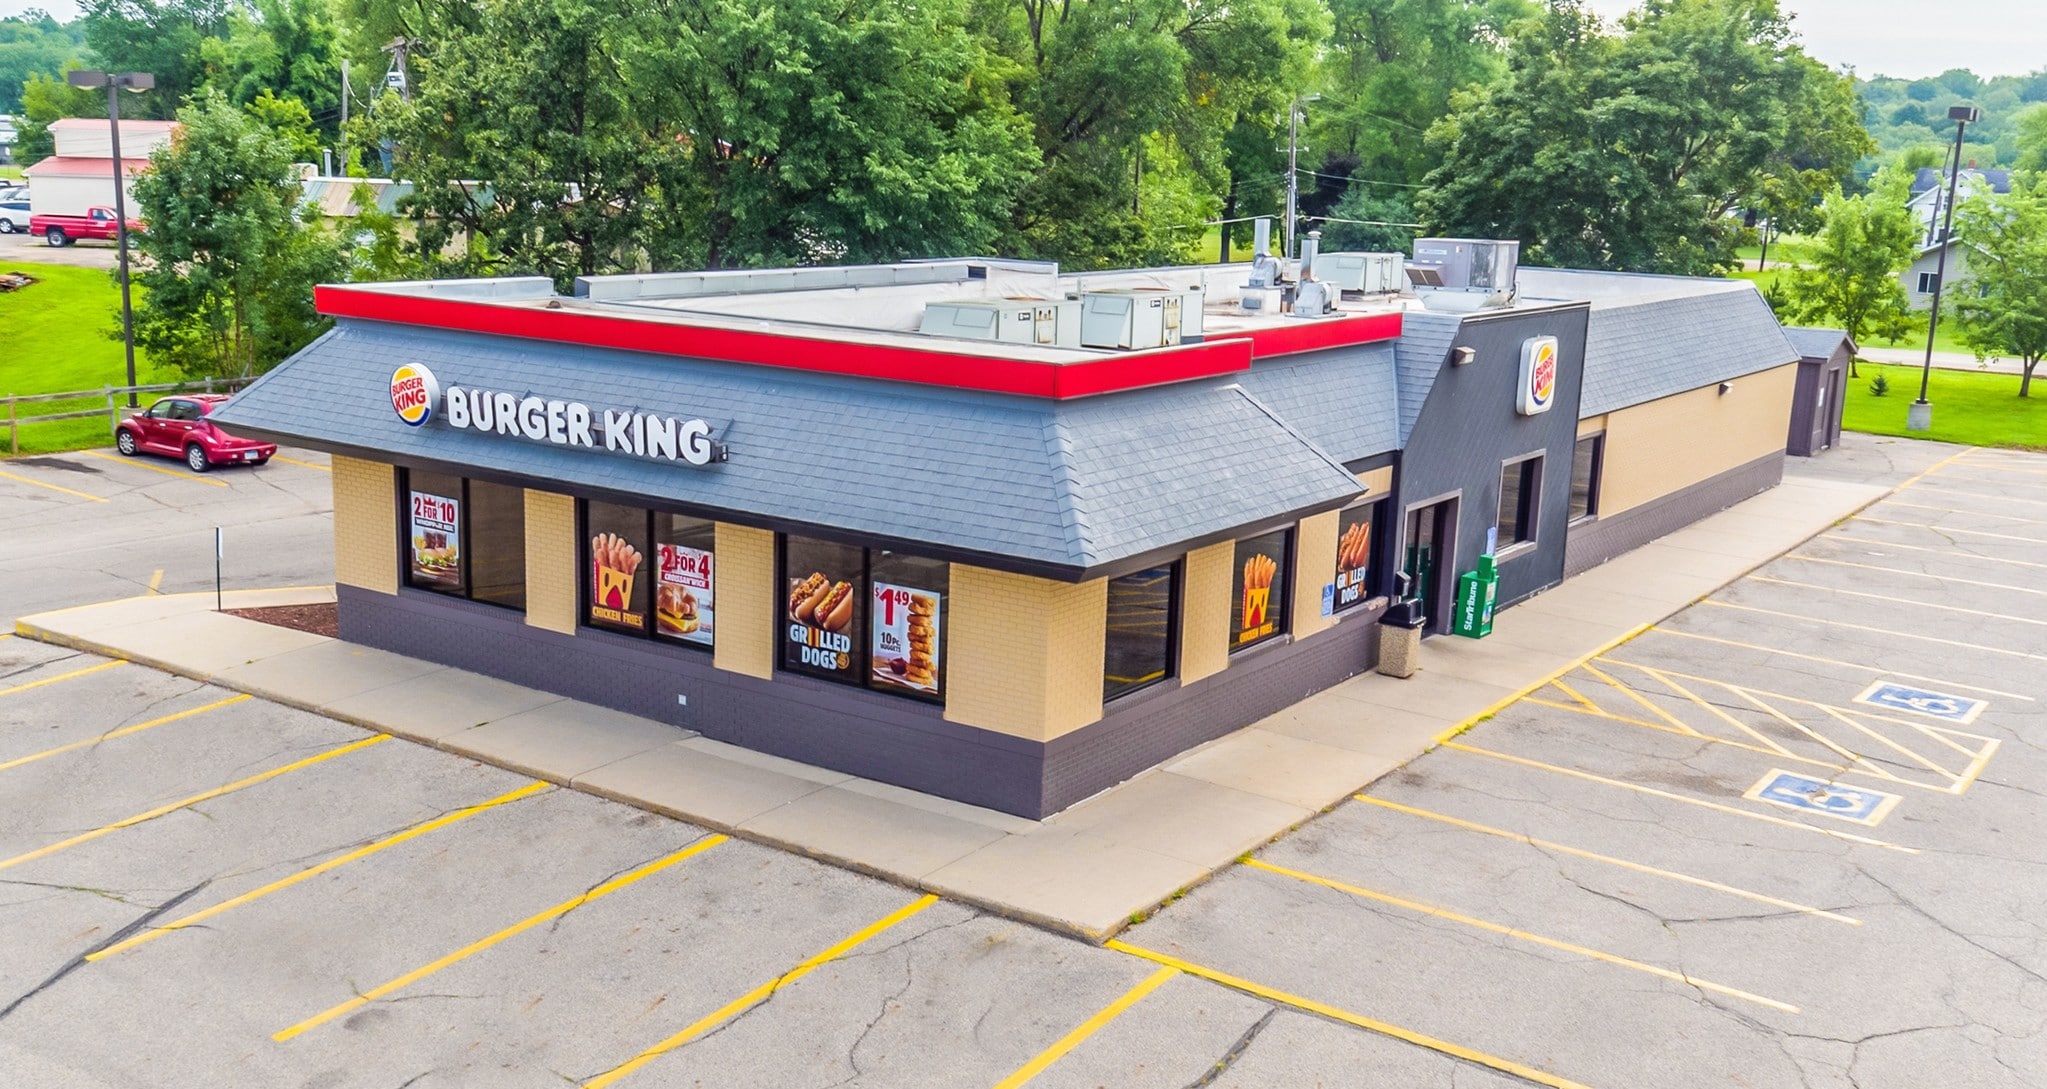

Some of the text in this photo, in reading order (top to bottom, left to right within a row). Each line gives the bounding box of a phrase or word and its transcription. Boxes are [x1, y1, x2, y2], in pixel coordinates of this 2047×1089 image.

[392, 377, 423, 396] BURGER
[395, 388, 426, 413] KING
[446, 386, 713, 466] BURGER KING
[414, 496, 421, 516] 2
[423, 506, 437, 520] FOR
[661, 546, 672, 572] 2
[675, 554, 695, 574] FOR
[592, 606, 643, 627] CHICKEN FRIES
[789, 624, 851, 653] GRILLED
[880, 643, 901, 653] NUGGETS
[881, 632, 892, 645] 10
[801, 646, 837, 670] DOGS
